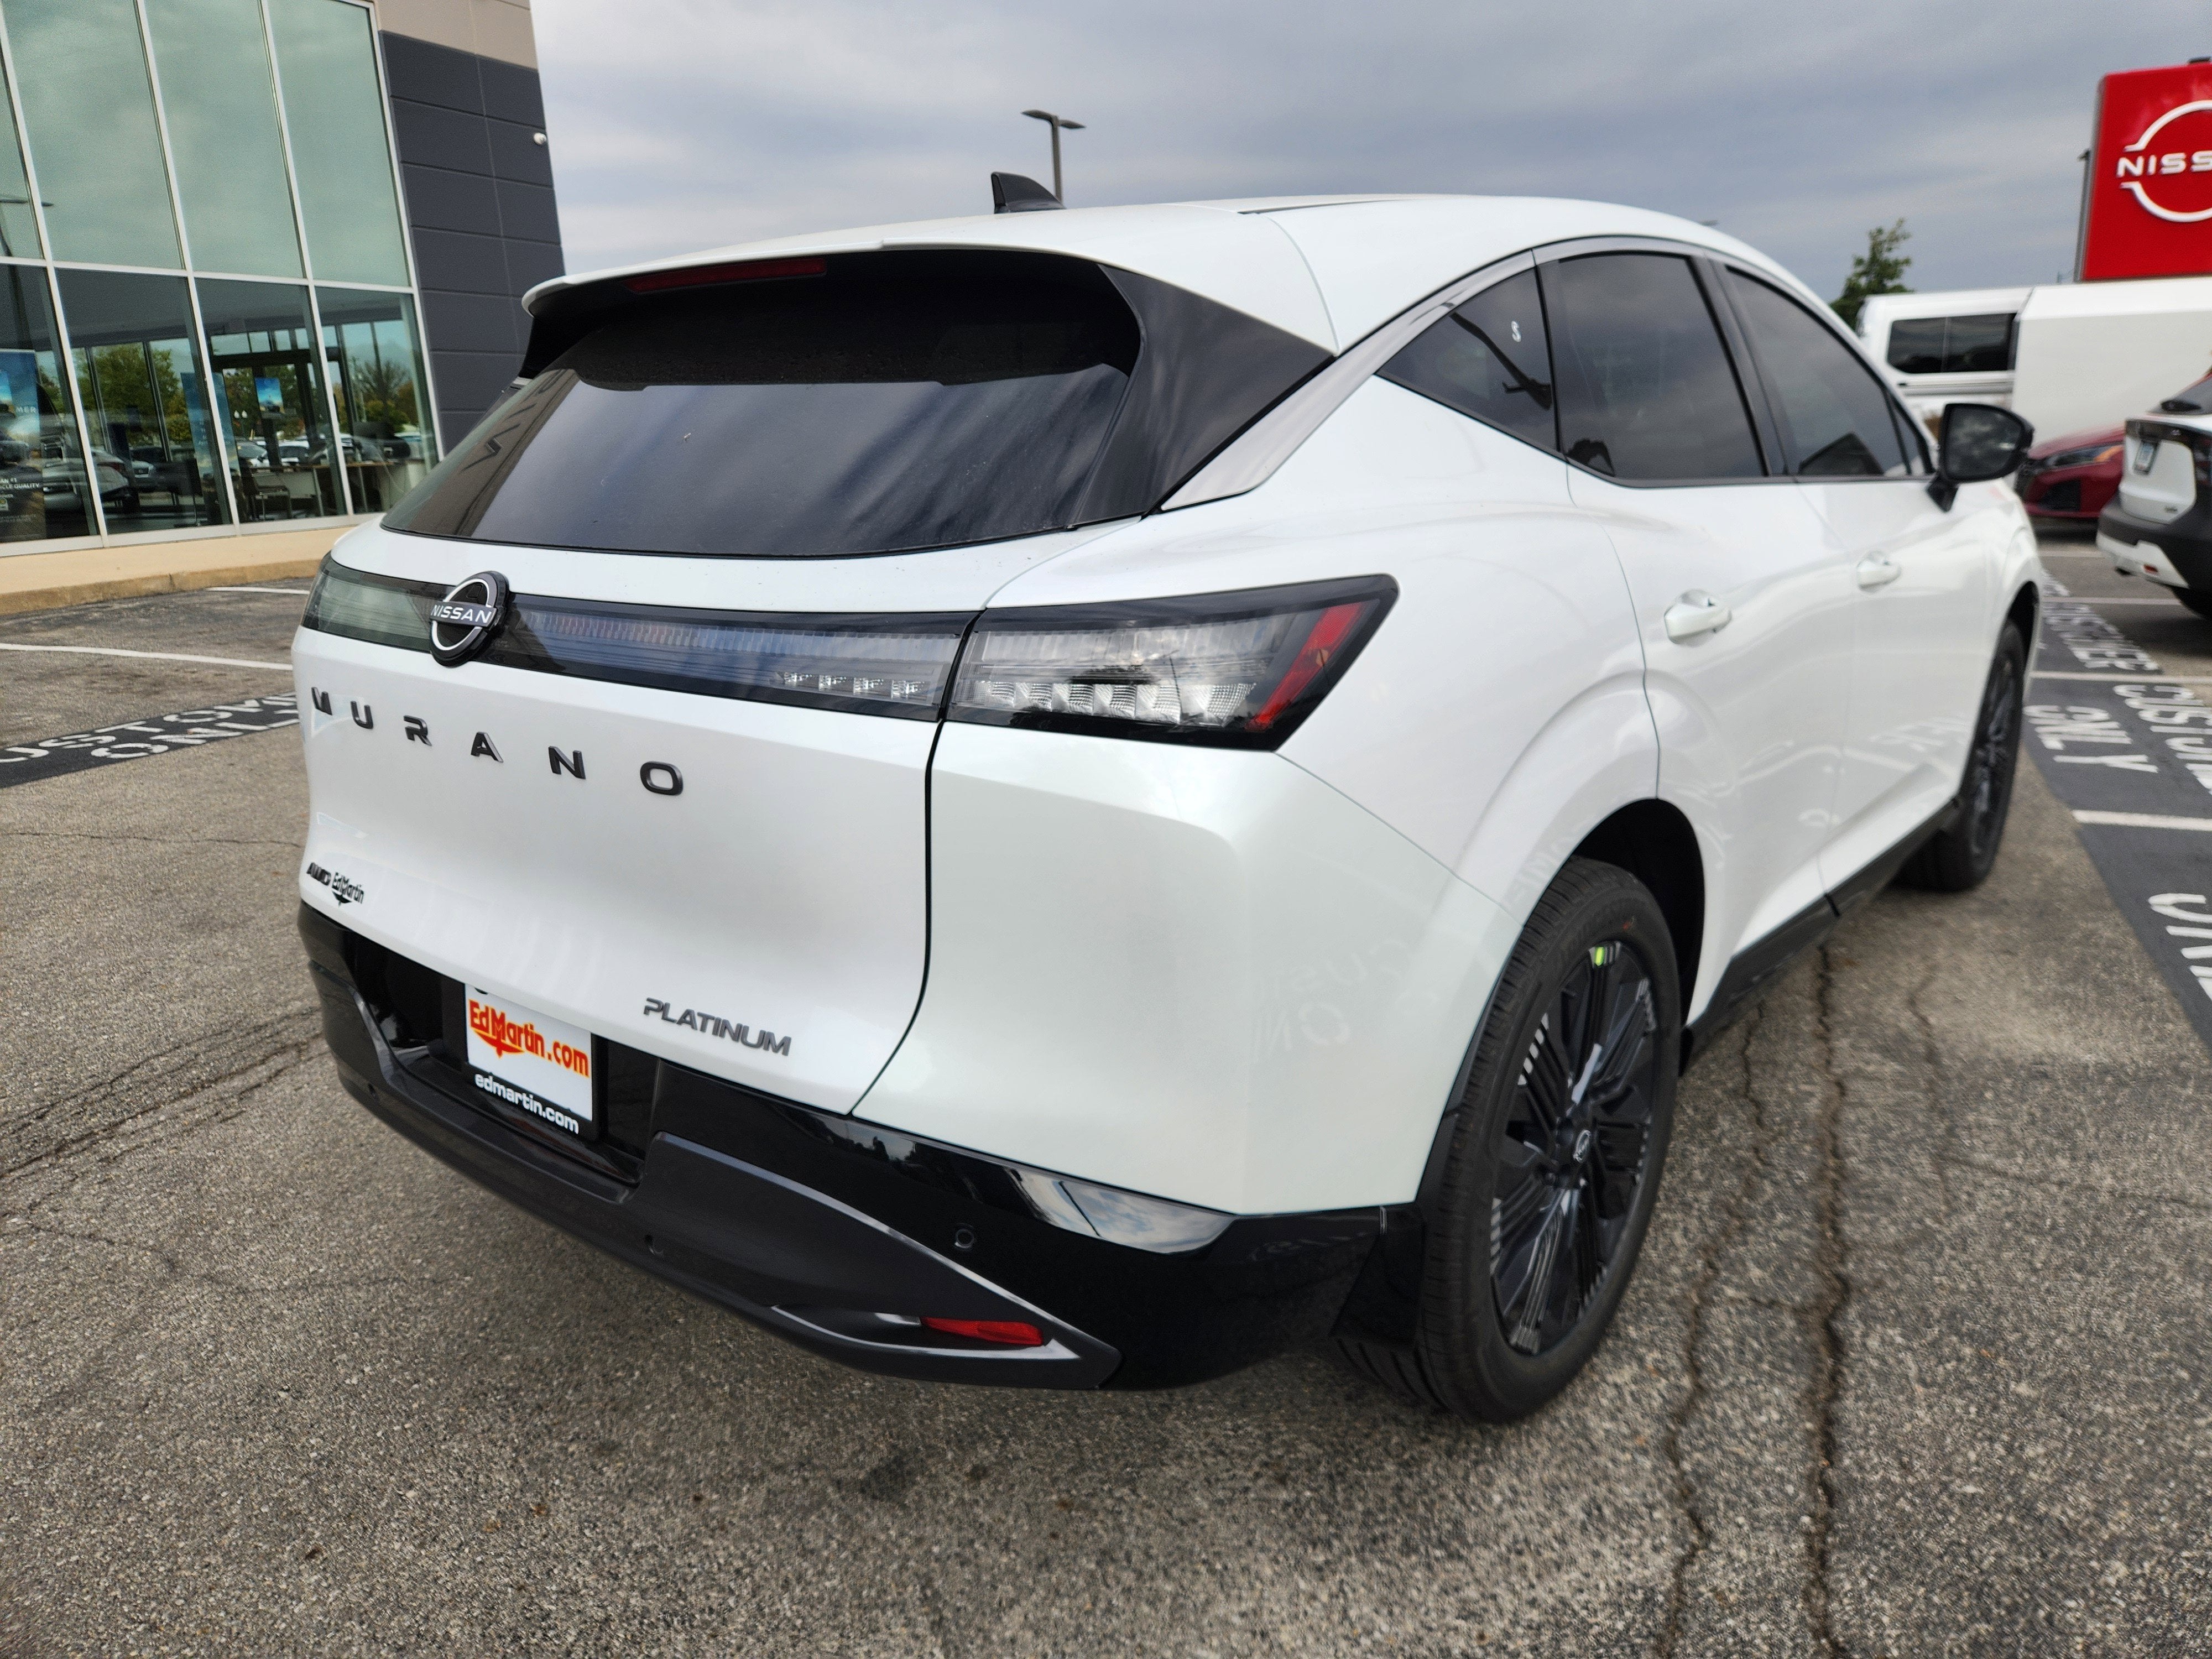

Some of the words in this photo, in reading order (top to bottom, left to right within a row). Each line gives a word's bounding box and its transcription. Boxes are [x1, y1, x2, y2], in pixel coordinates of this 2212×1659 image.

[2116, 150, 2212, 177] NISS
[430, 604, 492, 623] NISSAN
[312, 687, 684, 795] MURANO
[306, 862, 331, 886] AWD
[643, 997, 792, 1057] PLATINUM
[474, 1074, 579, 1134] edmartin.com
